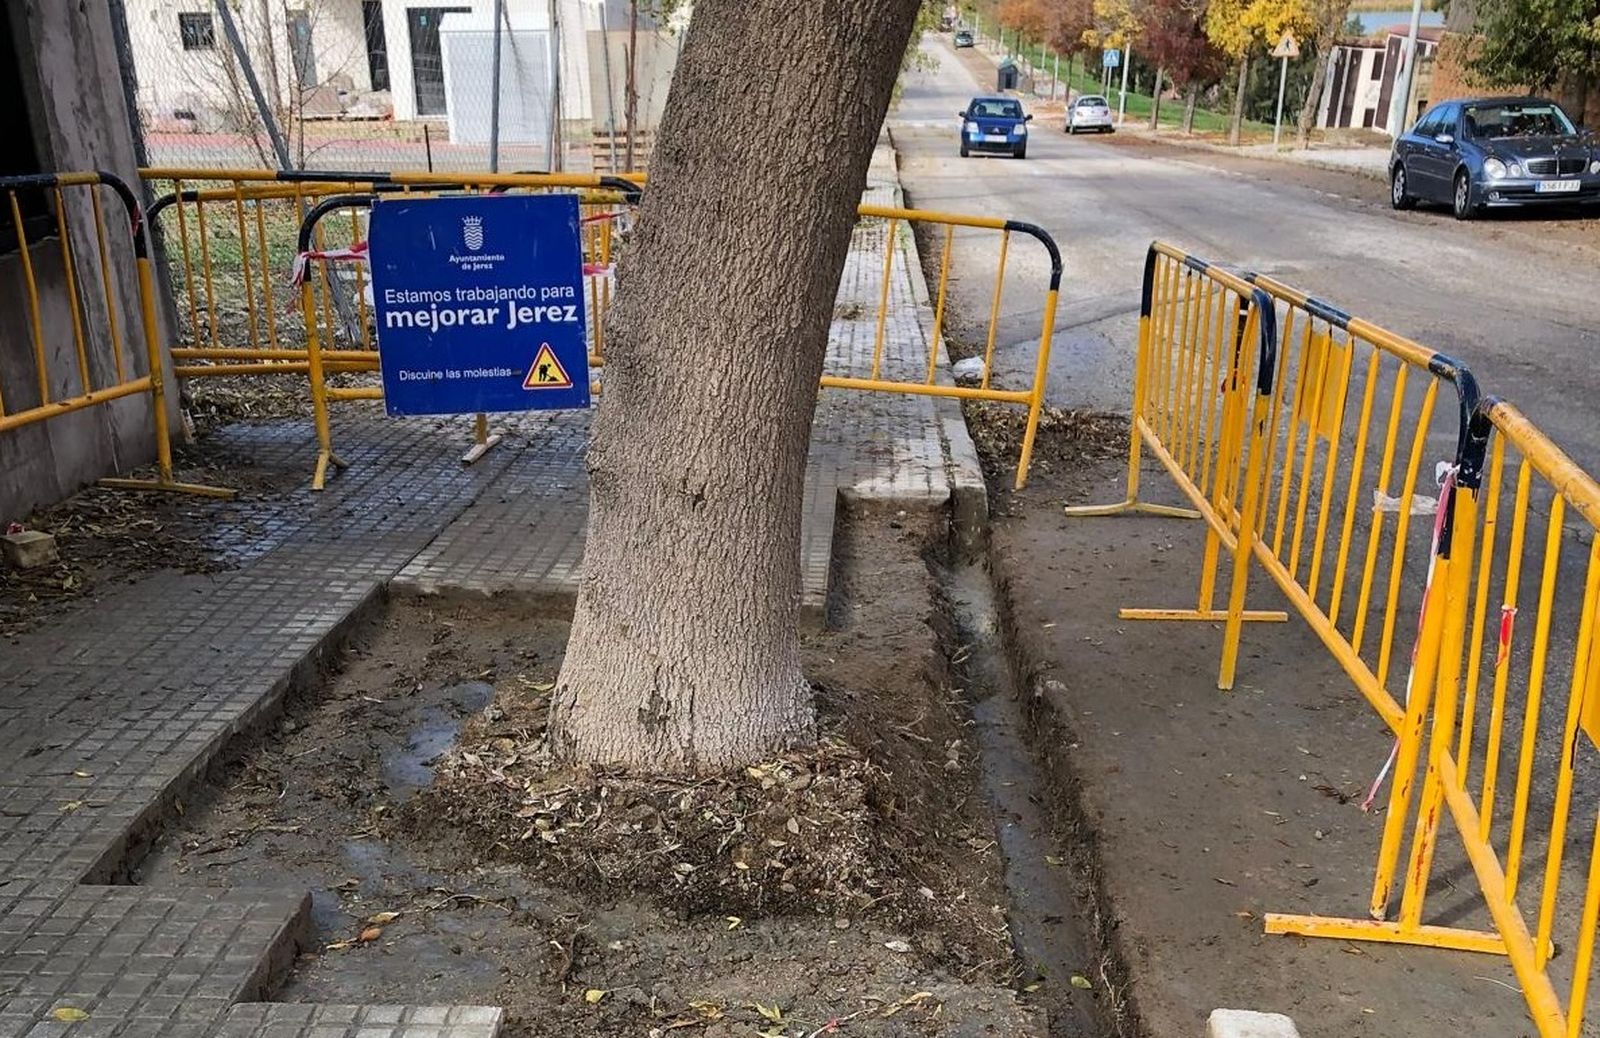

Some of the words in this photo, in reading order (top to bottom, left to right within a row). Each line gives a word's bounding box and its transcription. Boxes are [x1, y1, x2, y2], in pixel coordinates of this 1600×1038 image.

[449, 254, 505, 264] Ayuntamiento
[473, 263, 493, 271] Jerez
[385, 288, 451, 304] Estamos
[455, 285, 536, 304] trabajando
[541, 286, 574, 301] para
[386, 304, 499, 333] mejorar
[507, 301, 578, 330] Jerez
[446, 369, 460, 379] las
[463, 366, 512, 378] molestias
